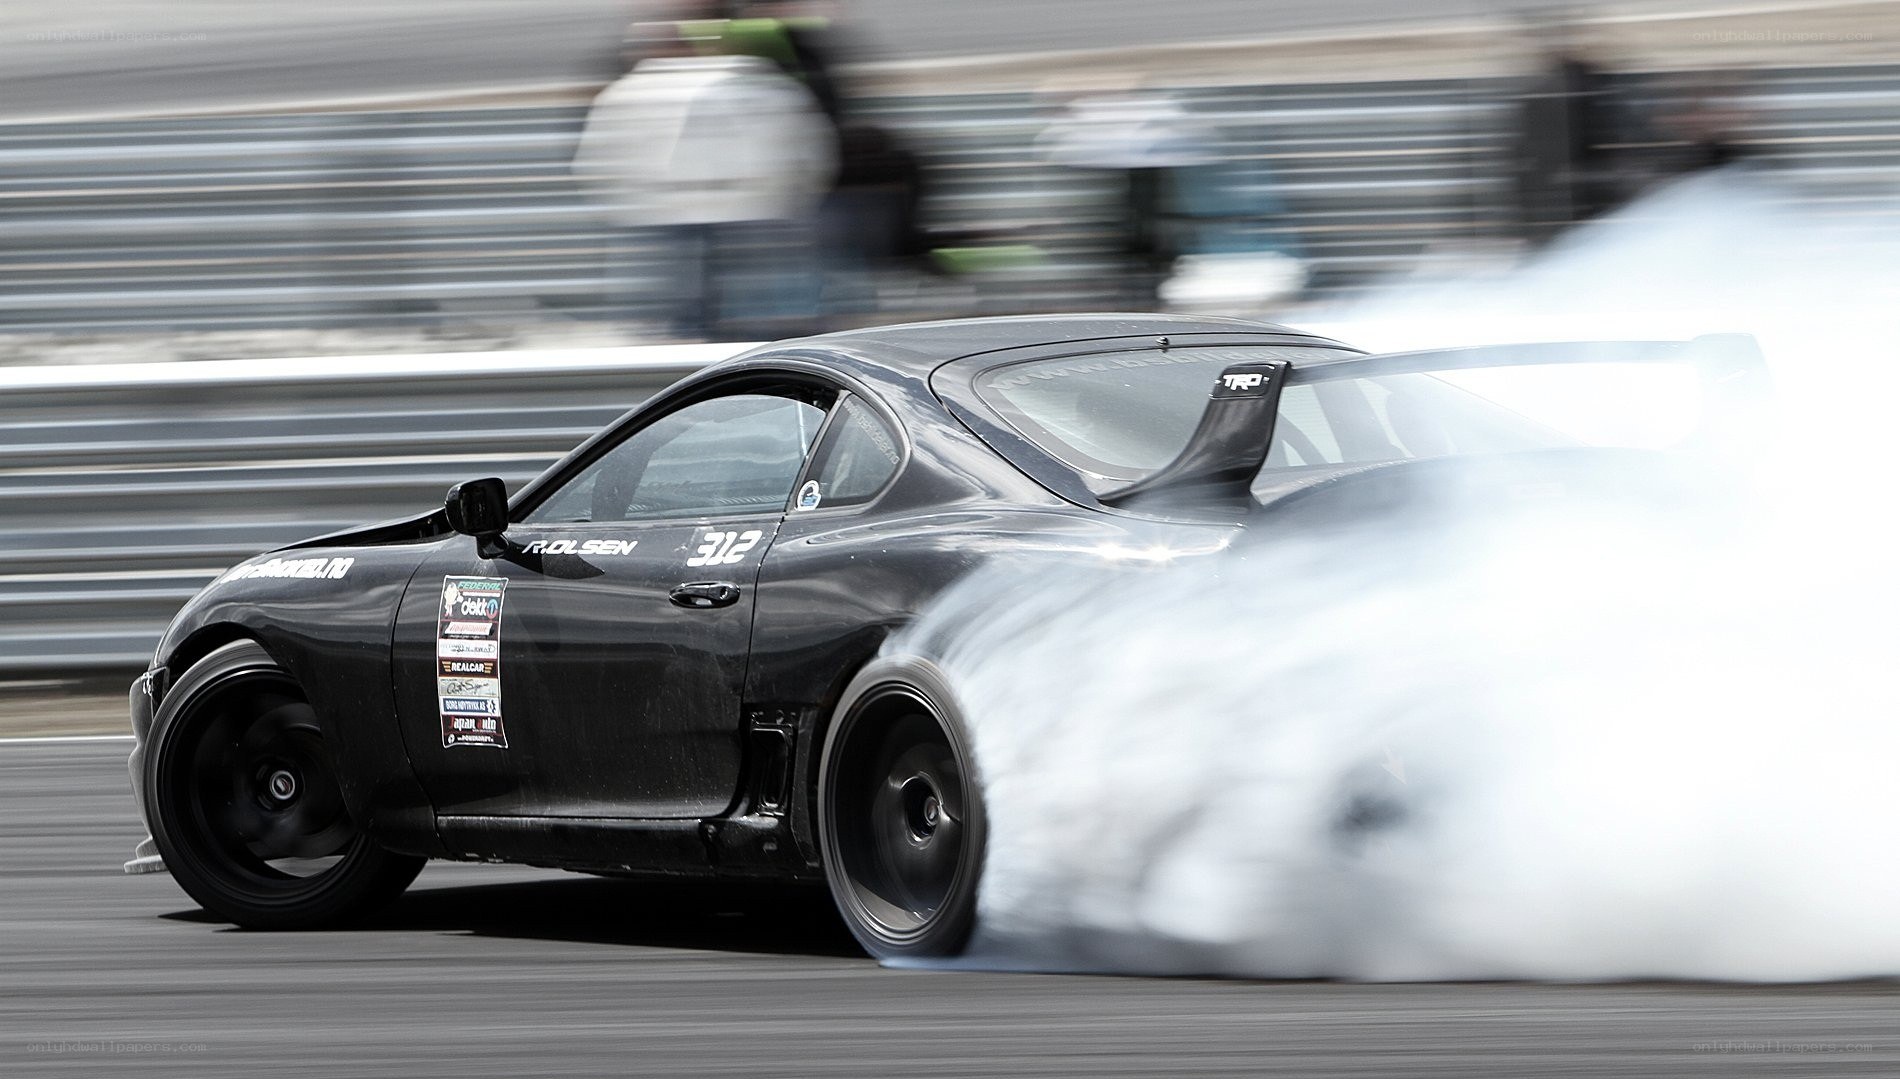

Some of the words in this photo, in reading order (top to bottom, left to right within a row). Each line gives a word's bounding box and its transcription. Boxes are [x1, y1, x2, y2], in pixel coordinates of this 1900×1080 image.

[522, 540, 638, 555] R.OLSEN
[687, 530, 762, 567] 312
[457, 581, 503, 590] FEDERAL
[451, 662, 485, 673] REALCAR
[449, 715, 476, 731] Japan
